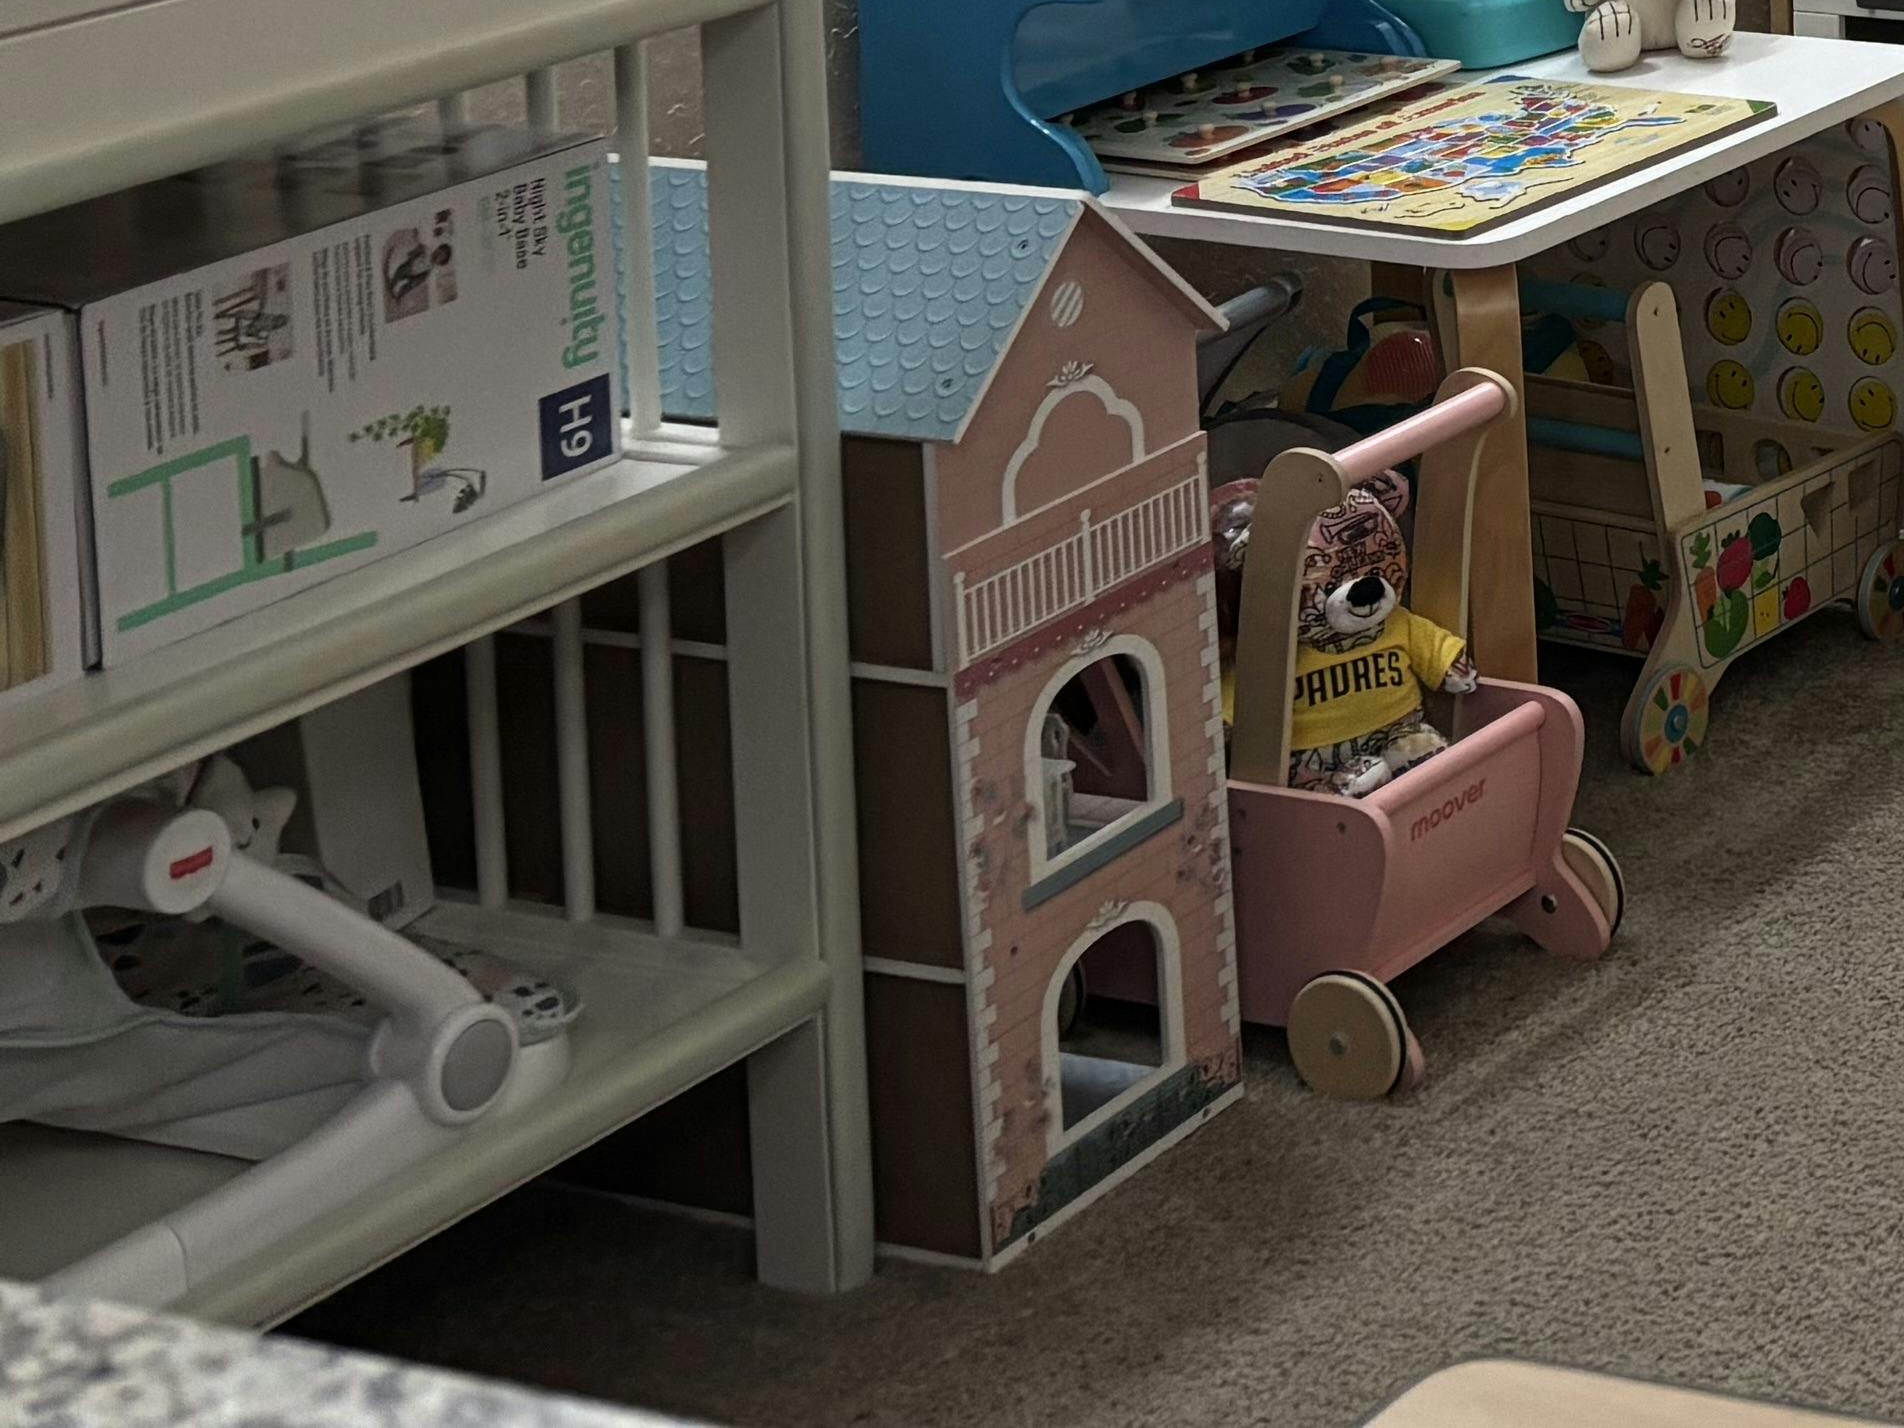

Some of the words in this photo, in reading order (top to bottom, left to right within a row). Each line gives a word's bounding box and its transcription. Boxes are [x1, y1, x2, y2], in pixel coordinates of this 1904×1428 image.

[556, 161, 604, 369] ingenuity
[559, 394, 593, 458] H9
[1411, 778, 1486, 841] moover
